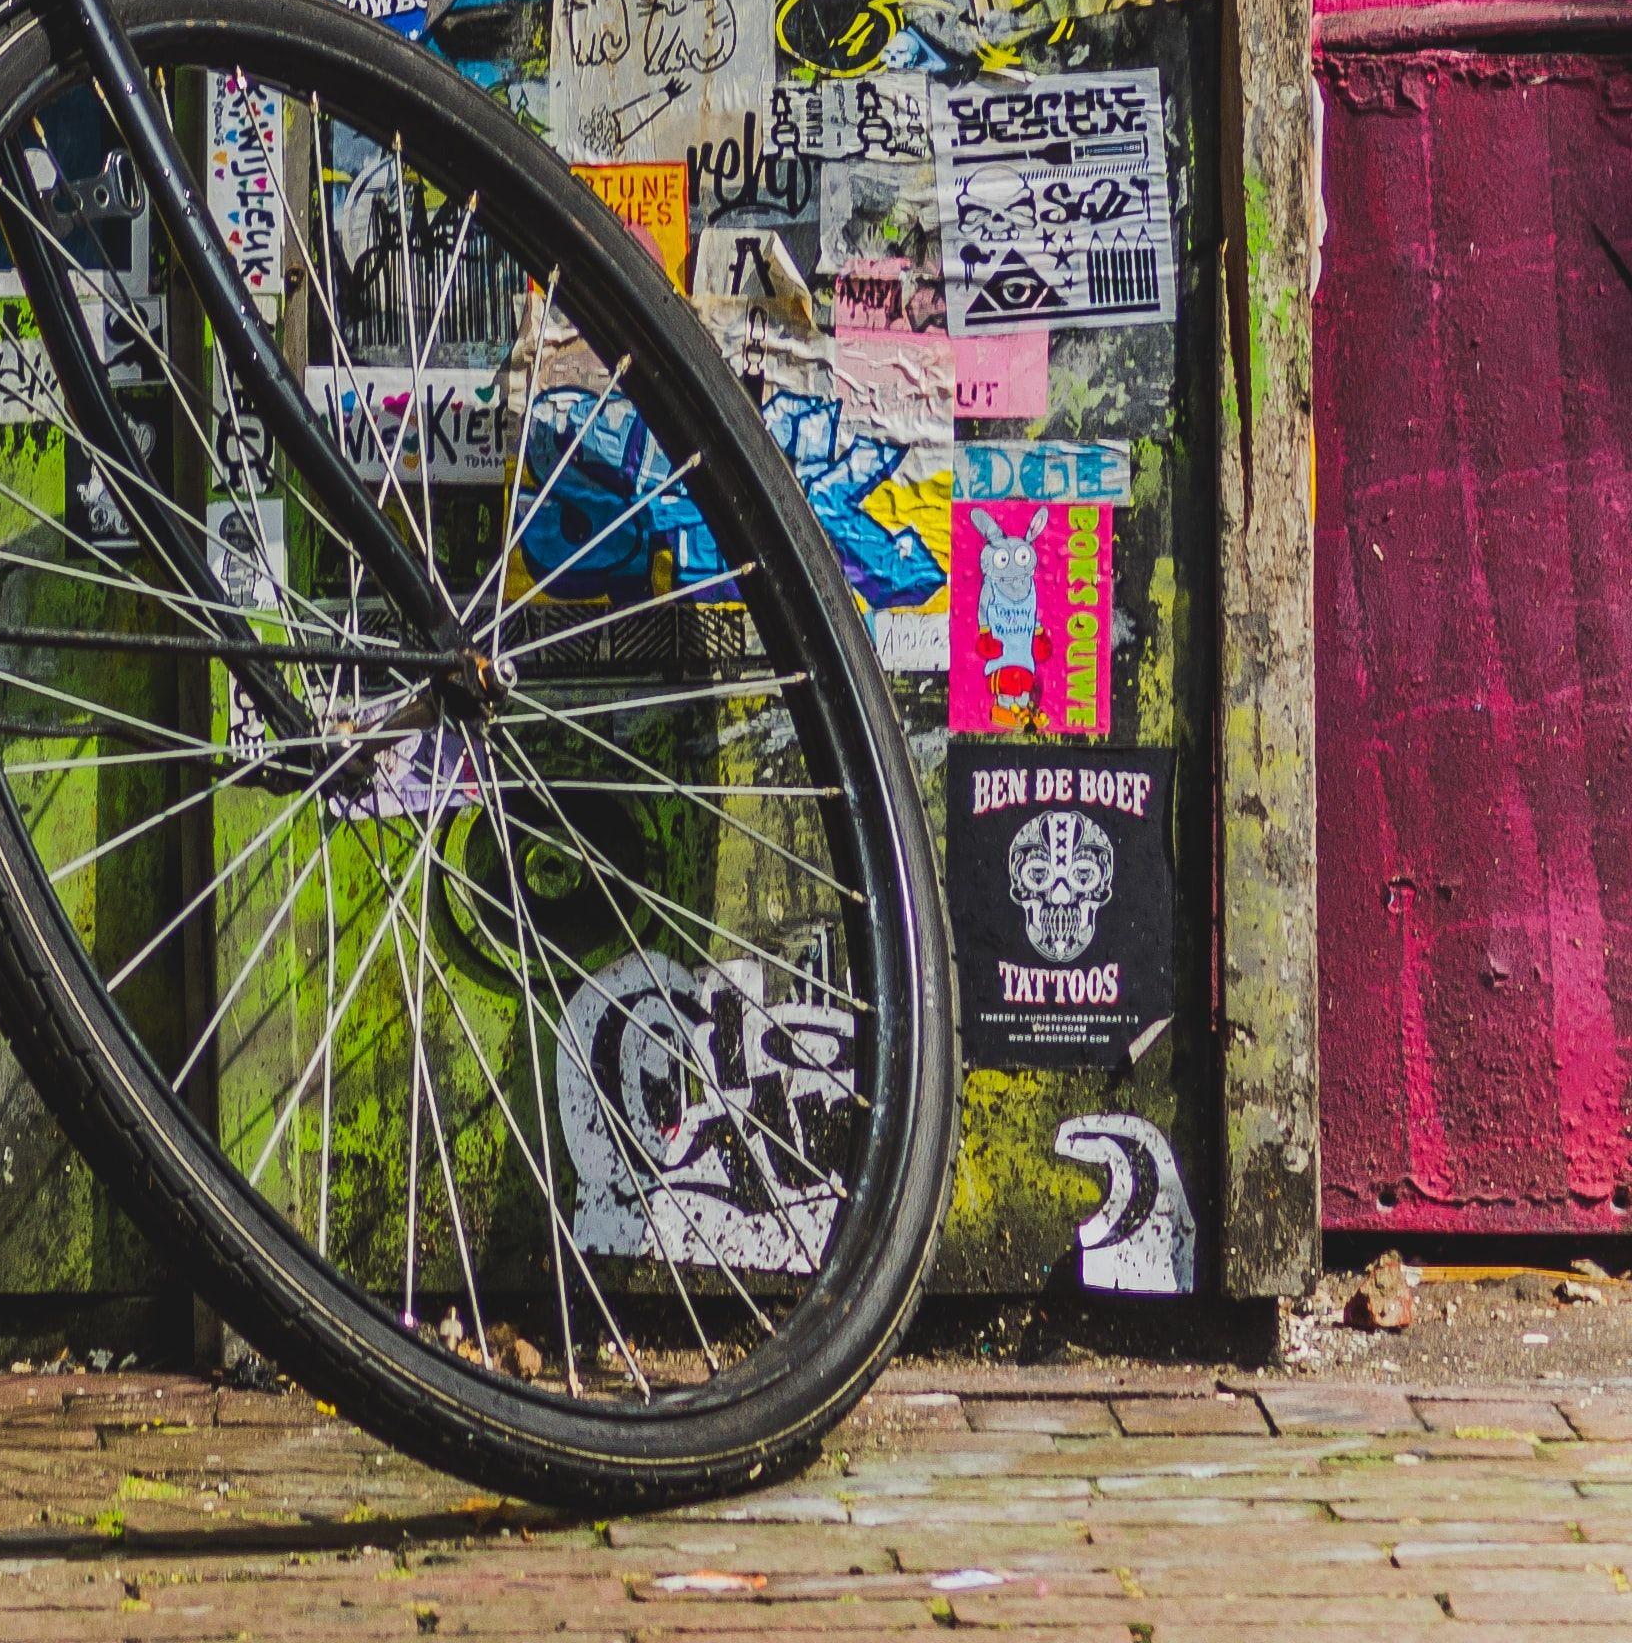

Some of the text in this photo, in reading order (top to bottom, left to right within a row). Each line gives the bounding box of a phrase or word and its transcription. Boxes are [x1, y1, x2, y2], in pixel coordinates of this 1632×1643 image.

[958, 446, 1125, 500] DGE
[1067, 504, 1100, 606] BOKS
[1066, 611, 1100, 728] OUWE
[972, 767, 1151, 816] BEN DE BOEF
[998, 960, 1119, 1004] TATTOOS
